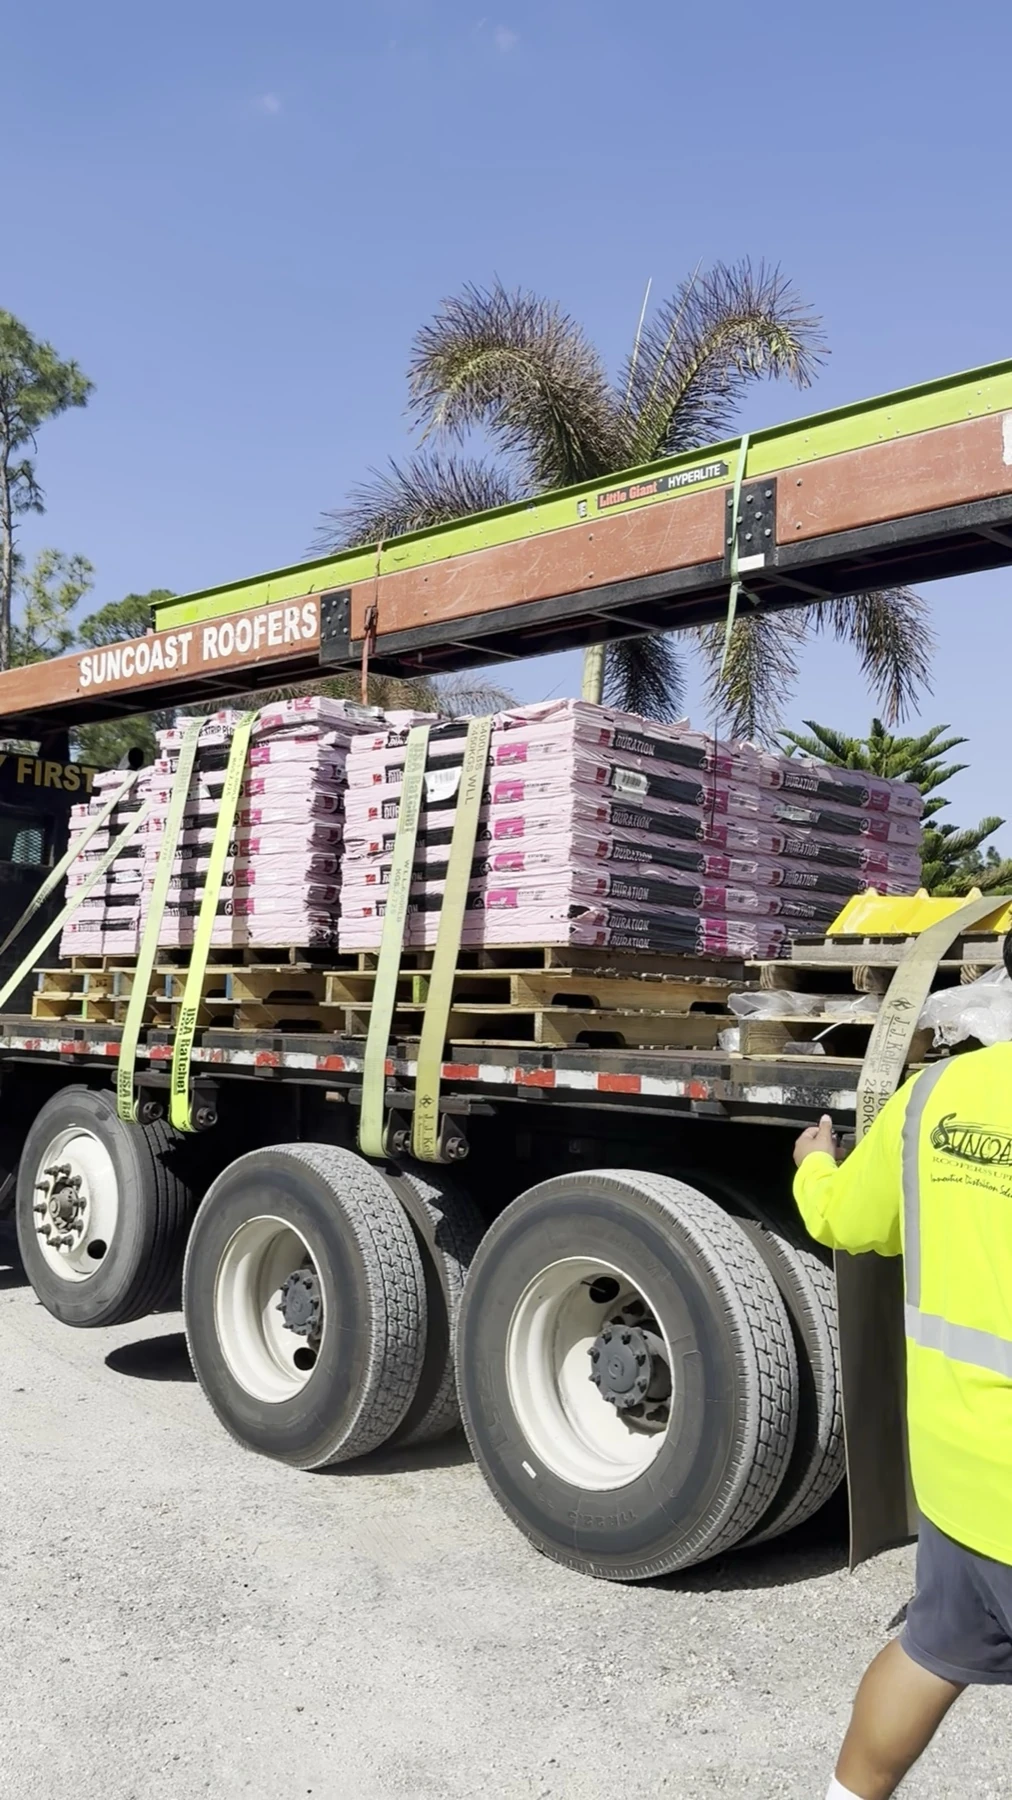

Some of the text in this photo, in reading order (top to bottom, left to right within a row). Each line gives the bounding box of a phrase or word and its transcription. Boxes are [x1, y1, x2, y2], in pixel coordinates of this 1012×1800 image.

[600, 464, 721, 507] Little Giant HYPERLITE
[79, 602, 318, 687] SUNCOAST ROOFERS
[614, 735, 656, 756] DURATION
[17, 757, 100, 793] FIRST
[784, 775, 820, 792] DURATION
[612, 811, 652, 829] DURATION
[612, 846, 653, 863] DURATION
[611, 883, 649, 900] DURATION
[609, 915, 650, 931] DURATION
[610, 935, 650, 949] DURATION
[182, 1007, 196, 1036] USA
[176, 1038, 192, 1095] Ratchet
[880, 1040, 903, 1076] Keller
[121, 1070, 132, 1098] USA
